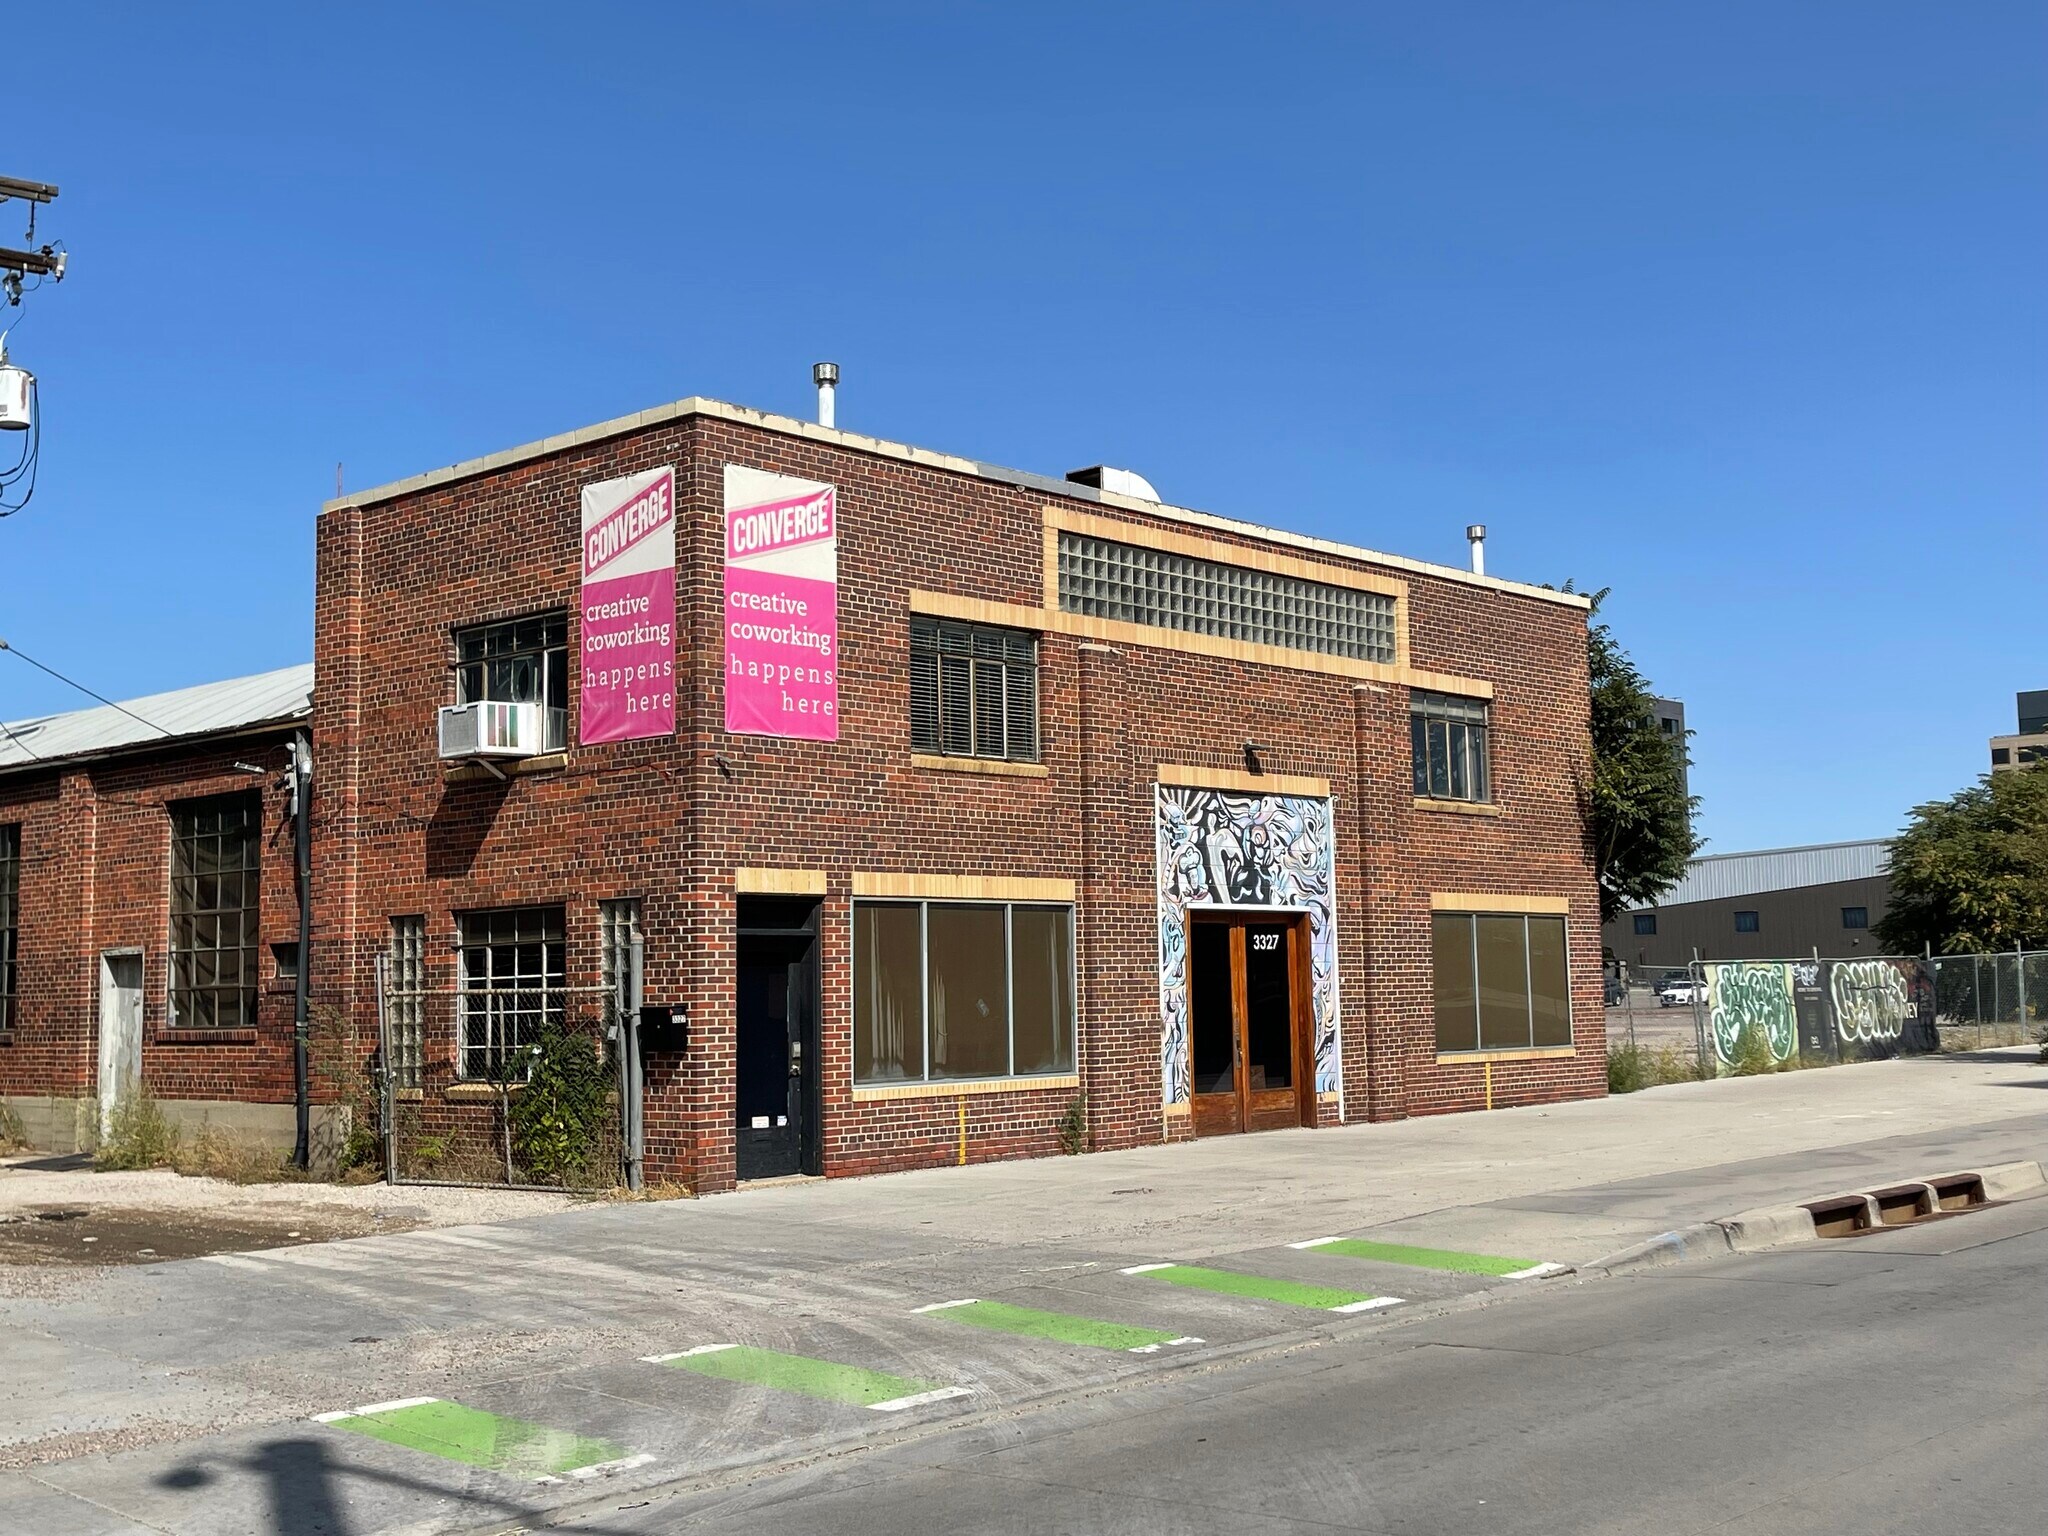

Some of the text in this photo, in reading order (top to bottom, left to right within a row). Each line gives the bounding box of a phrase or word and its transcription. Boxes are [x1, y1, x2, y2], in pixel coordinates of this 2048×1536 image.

[589, 483, 668, 568] CONVERGE
[733, 499, 828, 552] CONVERGE
[586, 593, 650, 622] creative
[730, 590, 808, 617] creative
[586, 622, 670, 651] coworking
[730, 621, 832, 655] coworking
[586, 659, 672, 690] happens
[730, 653, 834, 685] happens
[626, 692, 672, 713] here
[782, 691, 834, 715] here
[1253, 934, 1279, 950] 3327
